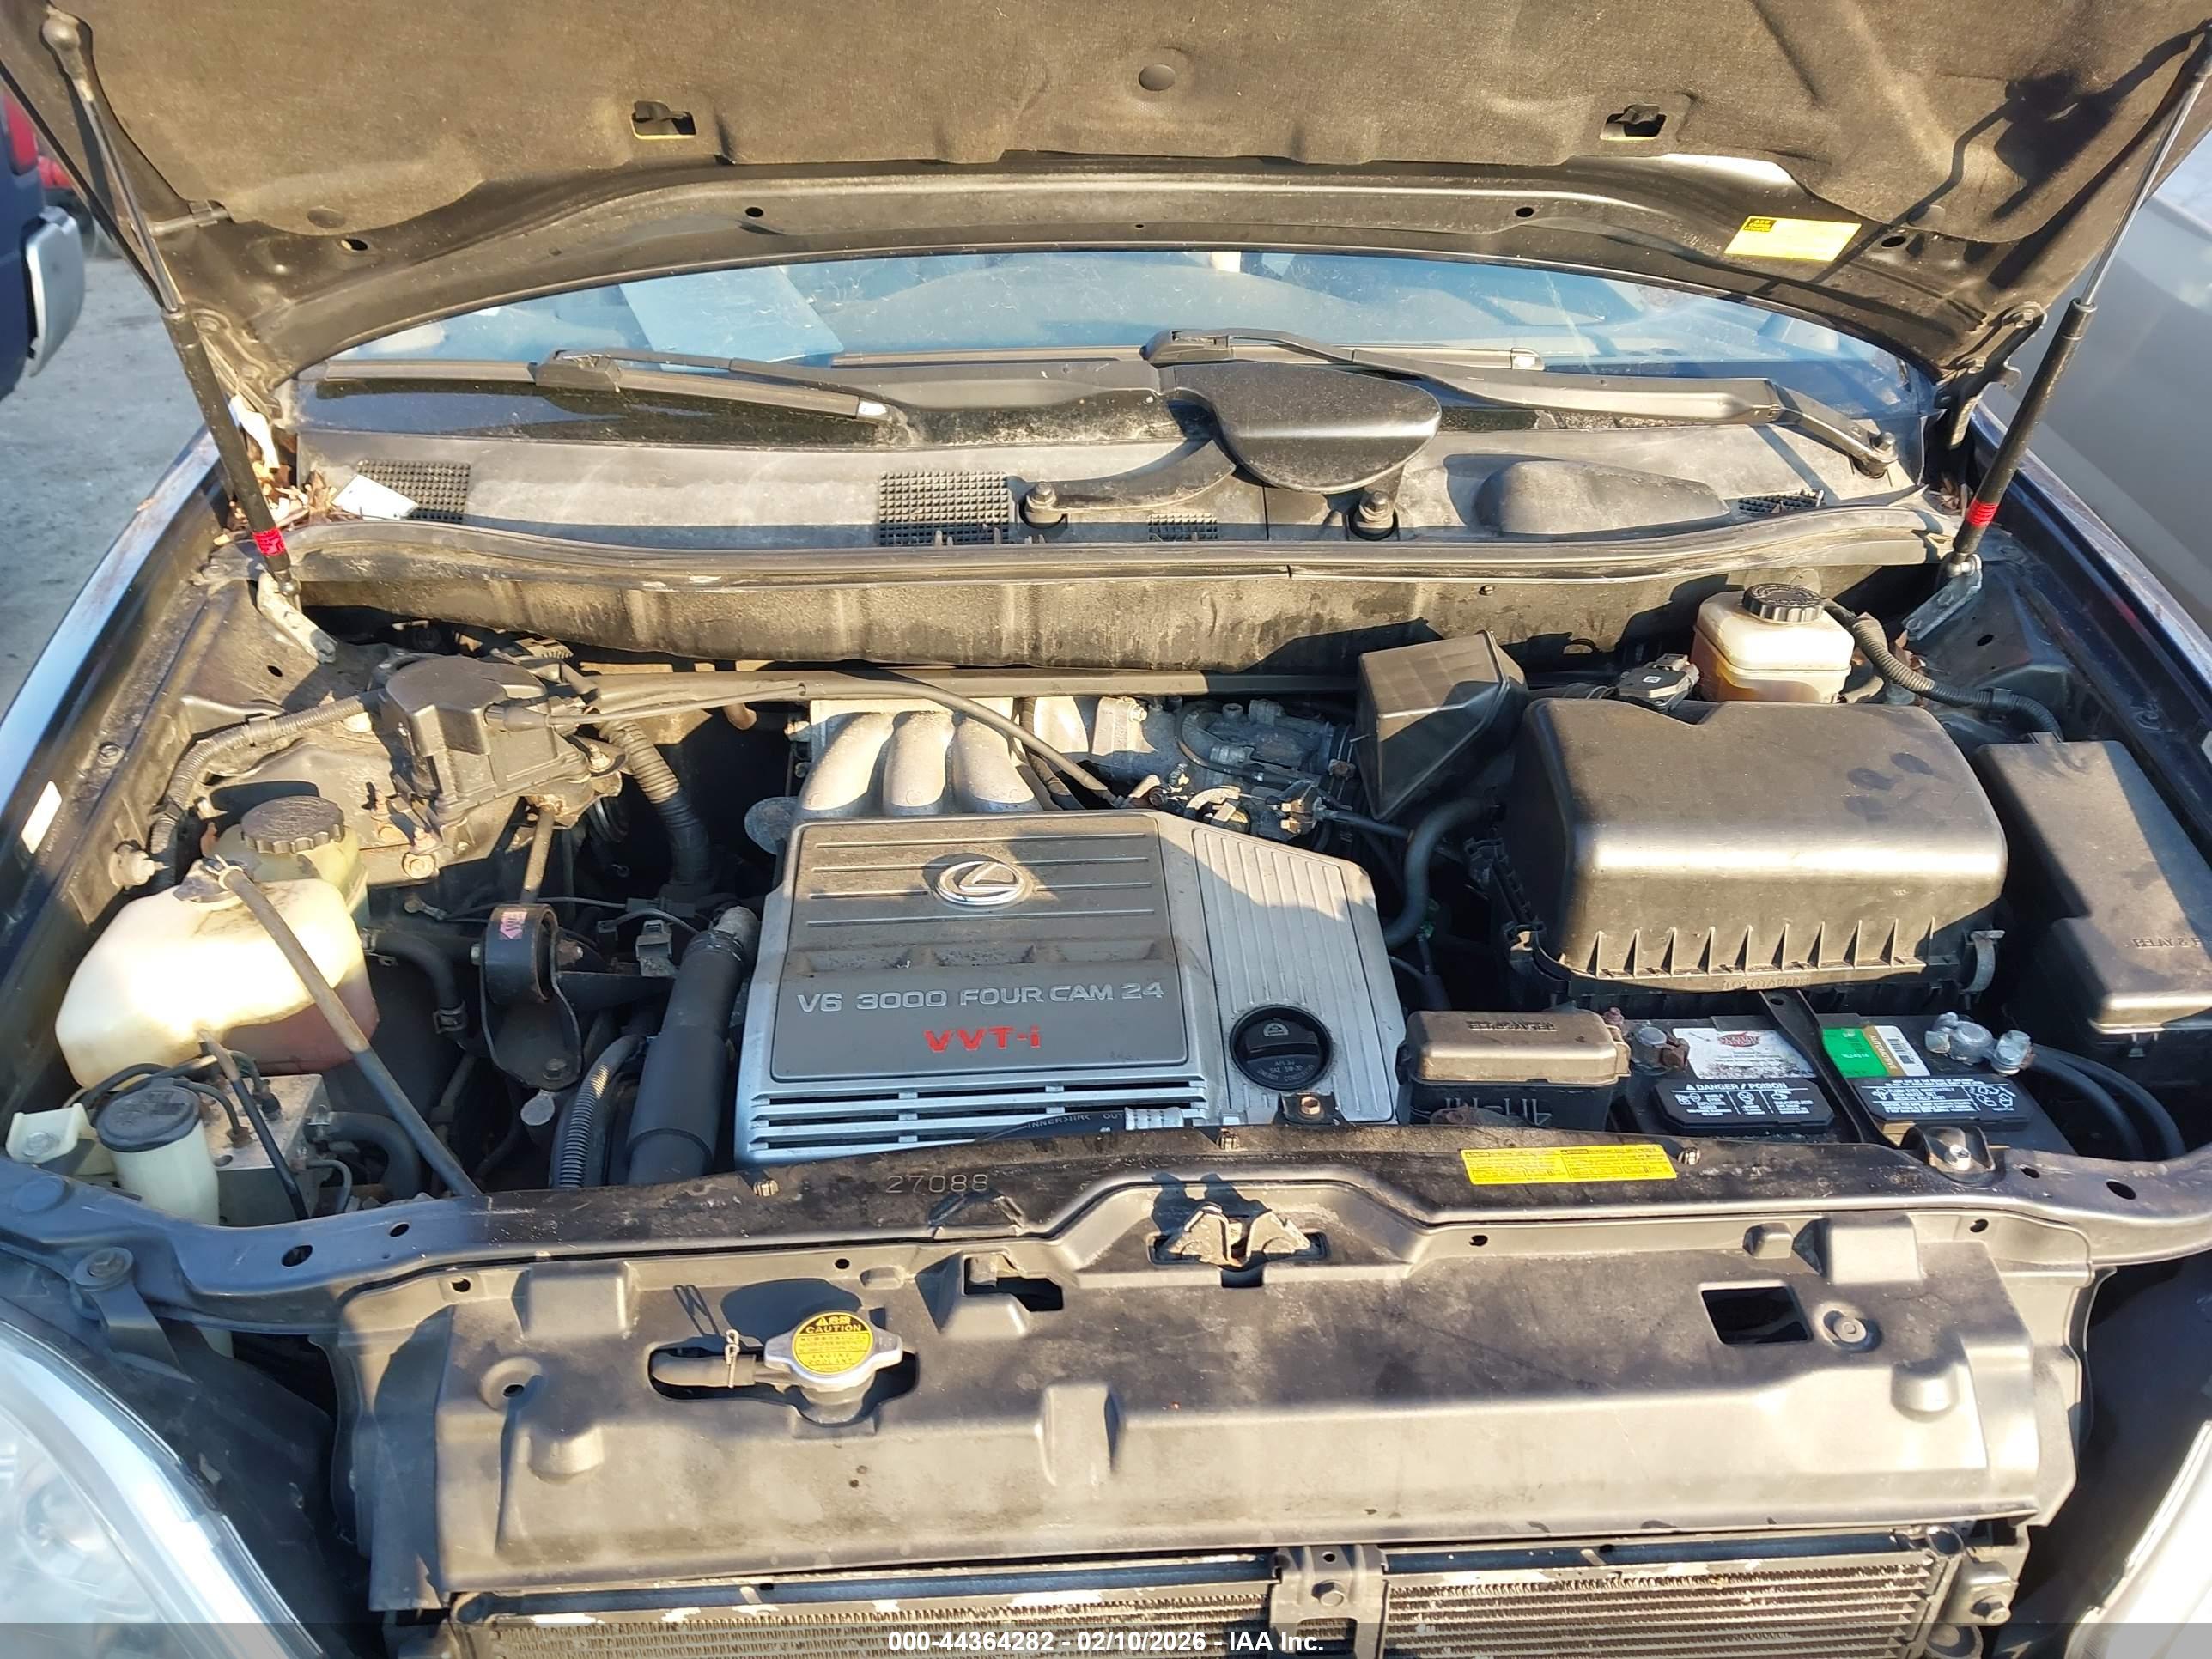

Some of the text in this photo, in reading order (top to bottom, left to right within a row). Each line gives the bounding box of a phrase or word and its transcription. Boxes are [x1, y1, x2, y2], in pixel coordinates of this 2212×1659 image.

[797, 981, 1164, 1012] V6 3000 FOUR CAM 24
[923, 1024, 1042, 1053] VVT-i
[885, 1174, 988, 1194] 27088
[805, 1324, 861, 1334] CAUTION
